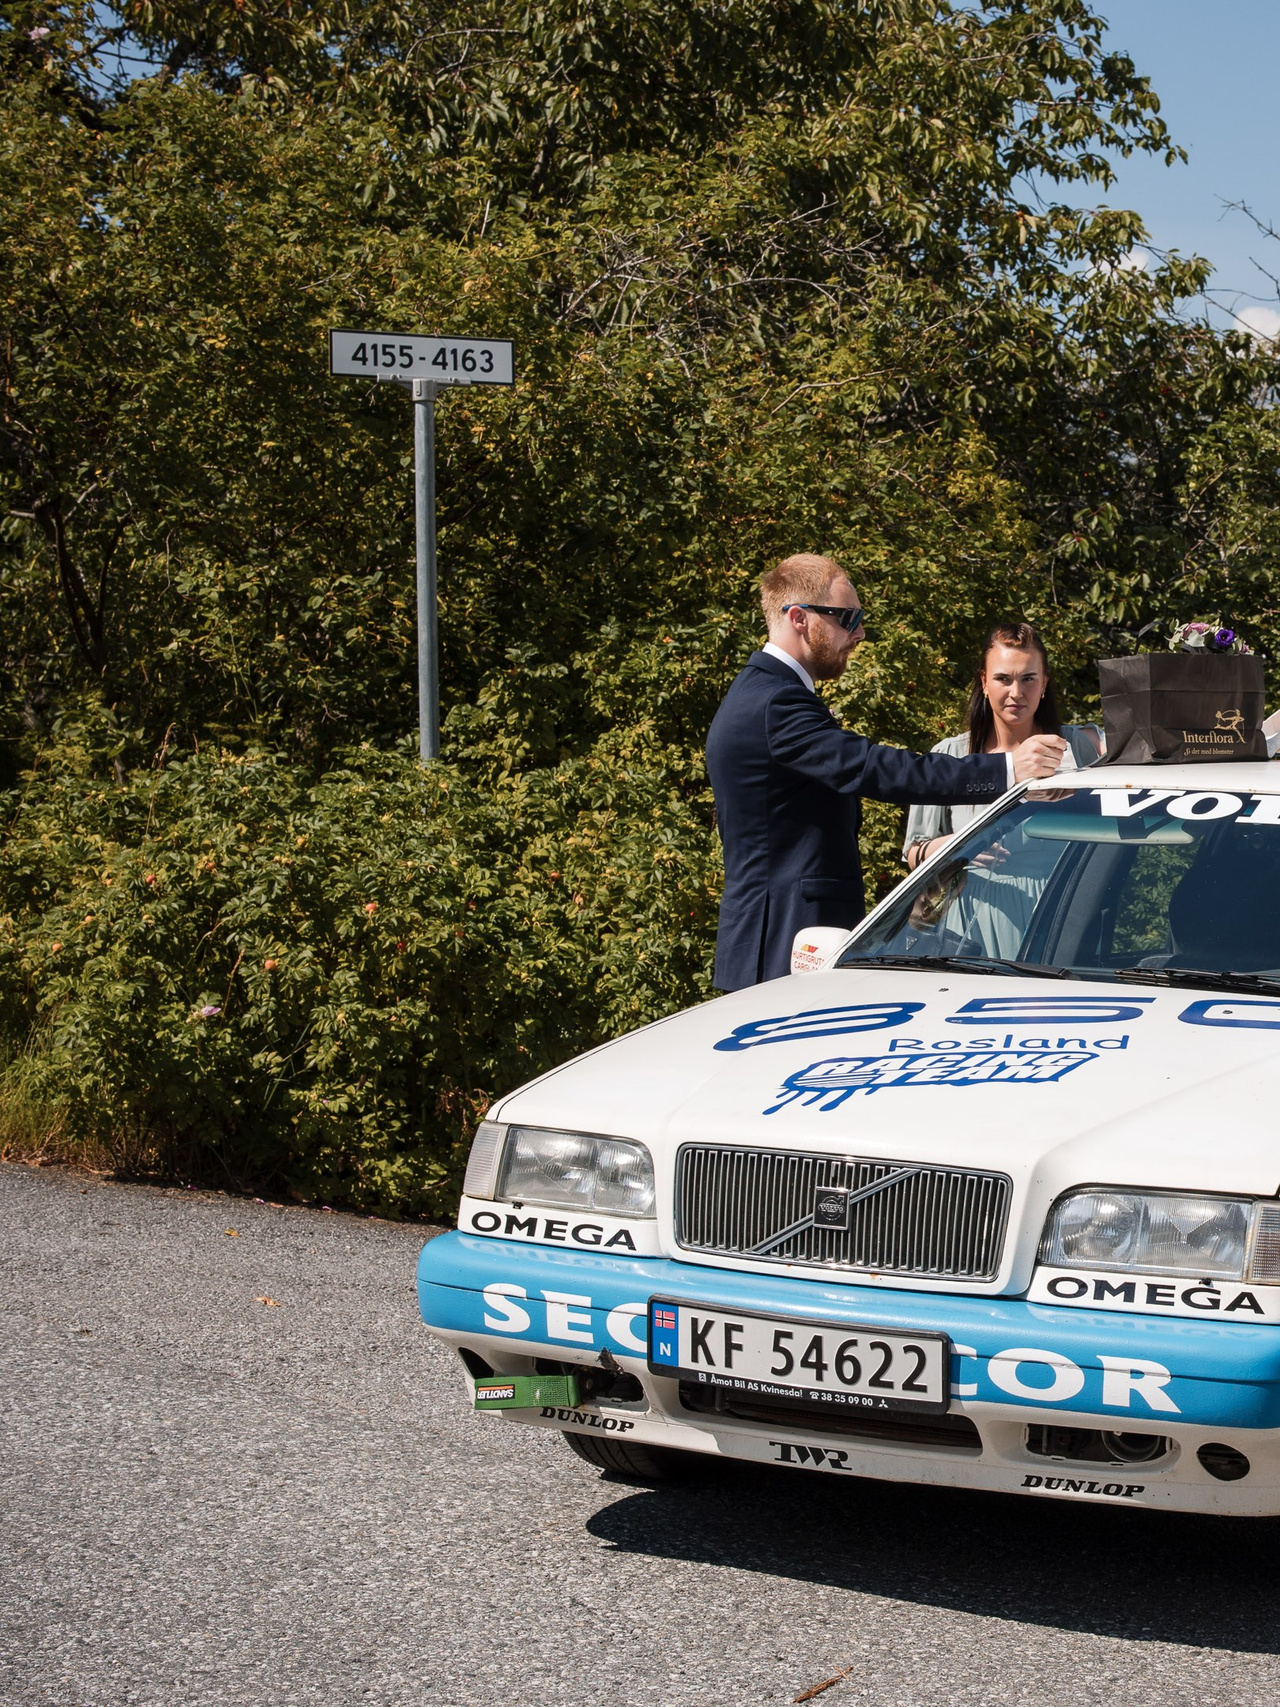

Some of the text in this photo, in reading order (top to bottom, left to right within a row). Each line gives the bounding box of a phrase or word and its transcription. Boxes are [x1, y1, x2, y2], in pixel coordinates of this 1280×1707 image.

[1182, 730, 1234, 744] Interflora
[888, 1033, 1130, 1052] Rosland
[802, 1053, 1086, 1078] RACING
[869, 1065, 1071, 1085] TEAM
[471, 1211, 637, 1251] OMEGA
[1047, 1276, 1266, 1315] OMEGA
[660, 1341, 671, 1357] N
[691, 1316, 928, 1394] KF 54622
[477, 1388, 515, 1400] SANDTLER
[710, 1373, 732, 1387] Åmot
[734, 1379, 746, 1389] Bil
[747, 1382, 759, 1391] AS
[821, 1392, 833, 1402] 38
[848, 1395, 860, 1405] 09
[861, 1397, 873, 1406] 00
[540, 1406, 635, 1433] DUNLOP
[769, 1441, 853, 1471] TWR
[1021, 1474, 1145, 1498] DUNLOP
